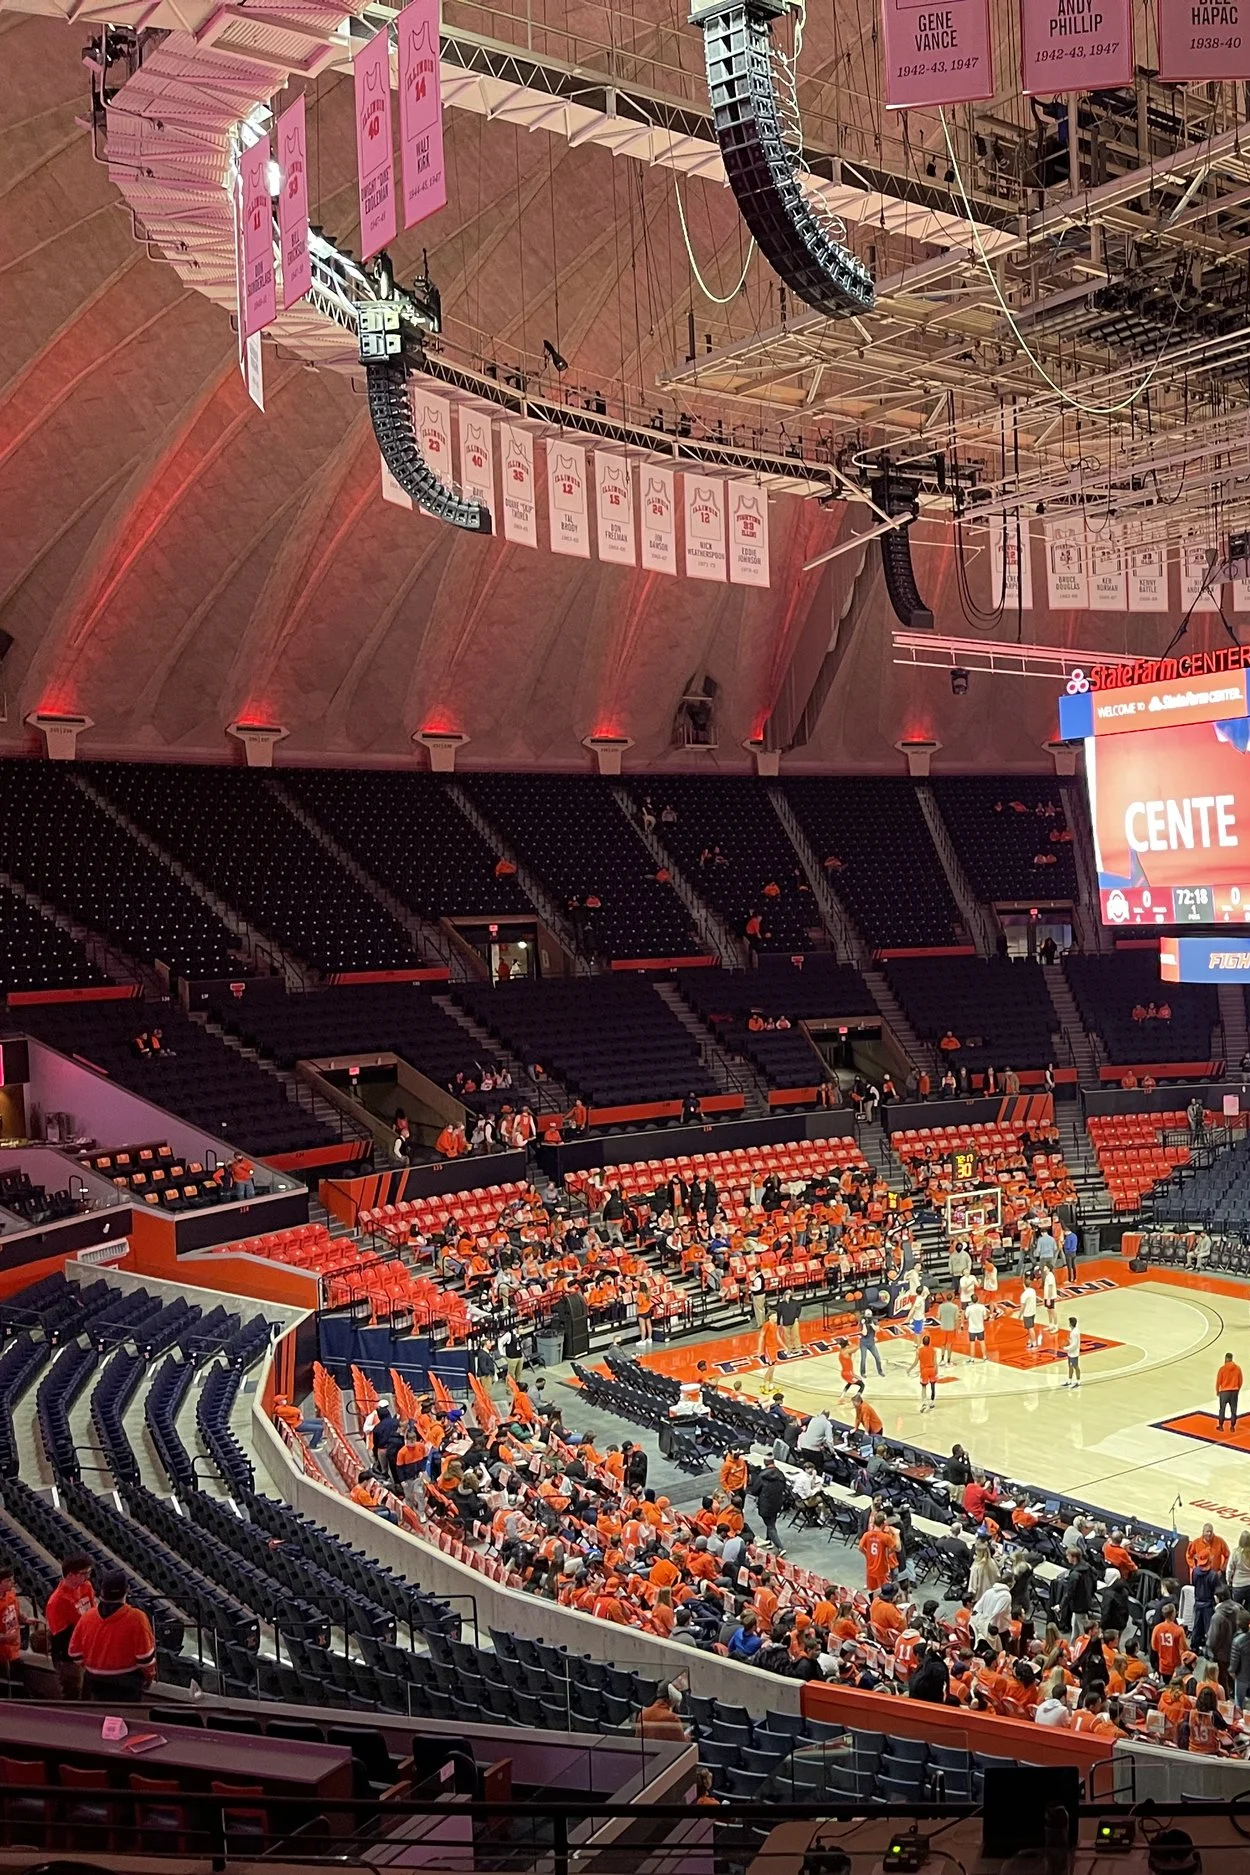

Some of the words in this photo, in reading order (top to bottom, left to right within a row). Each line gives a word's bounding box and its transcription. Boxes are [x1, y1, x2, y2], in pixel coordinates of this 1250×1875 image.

[1057, 0, 1093, 16] ANDY
[918, 11, 953, 32] GENE
[1191, 7, 1239, 25] HAPAC
[1050, 14, 1103, 37] PHILLIP
[915, 30, 958, 51] VANCE
[1189, 38, 1242, 50] 1938-40
[1035, 48, 1087, 63] 1942-43,
[1089, 43, 1119, 56] 1947
[897, 61, 948, 78] 1942-43,
[950, 57, 979, 70] 1947
[422, 428, 446, 445] ILLINOIS
[428, 438, 441, 452] 23
[467, 444, 488, 460] ILLINOIS
[471, 454, 483, 468] 40
[508, 460, 529, 475] ILLINOIS
[512, 469, 524, 483] 35
[554, 473, 581, 489] ILLINOIS
[562, 483, 574, 495] 12
[602, 485, 627, 499] ILLINOIS
[609, 494, 621, 505] 15
[647, 498, 669, 511] ILLINOIS
[652, 504, 663, 516] 24
[692, 504, 718, 518] ILLINOIS
[700, 512, 711, 524] 12
[604, 531, 628, 542] FREEMAN
[700, 541, 713, 550] NICK
[741, 547, 757, 557] EDDIE
[687, 548, 725, 560] WEATHERSPOON
[737, 555, 762, 566] JOHNSON
[1056, 583, 1080, 591] DOUGLAS
[1139, 579, 1156, 587] KENNY
[1097, 701, 1136, 718] WELCOME
[1124, 794, 1238, 853] CENTE
[1142, 890, 1152, 908] 0
[1176, 889, 1209, 905] 72:18
[1230, 887, 1241, 905] 0
[1190, 905, 1197, 914] 1
[957, 1163, 972, 1178] 30
[871, 1542, 878, 1555] 6
[1159, 1632, 1174, 1647] 13
[898, 1644, 912, 1660] 11
[1194, 1724, 1209, 1742] 13
